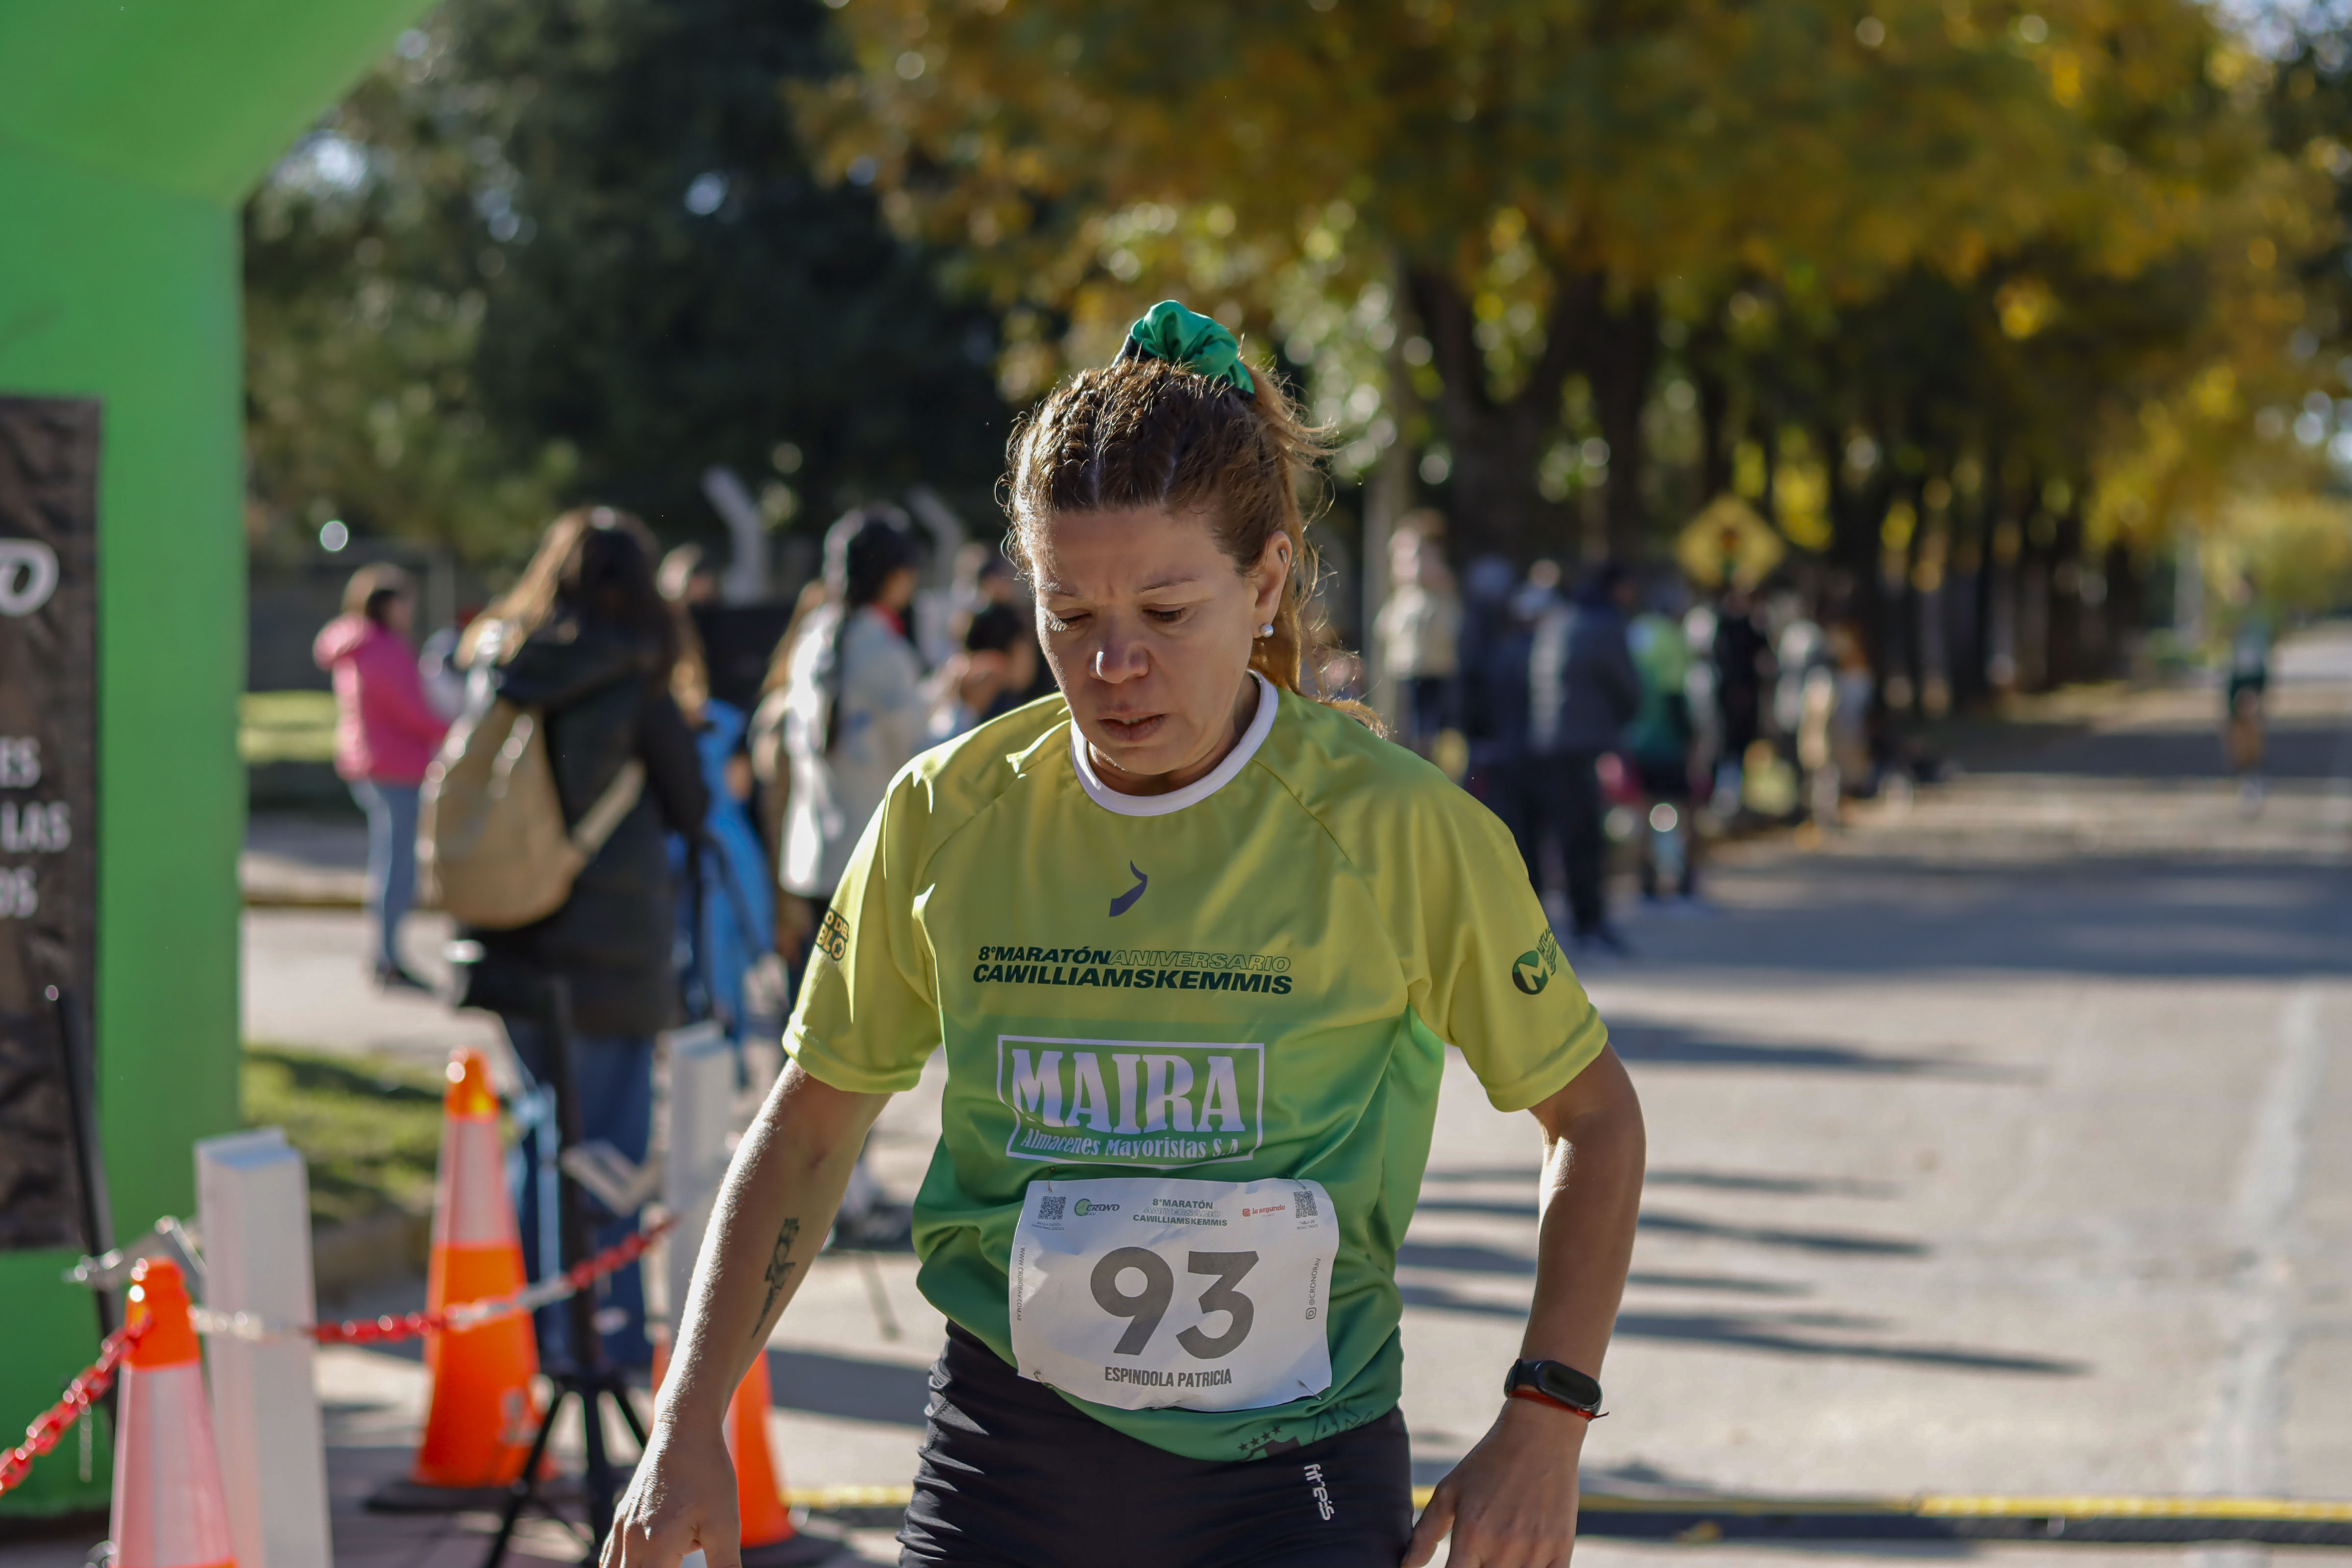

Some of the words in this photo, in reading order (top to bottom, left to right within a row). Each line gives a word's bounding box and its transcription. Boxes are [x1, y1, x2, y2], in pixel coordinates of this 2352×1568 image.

[973, 964, 1292, 995] CAWILLIAMSKEMMIS
[1012, 1049, 1246, 1134] MAIRA
[1021, 1128, 1101, 1155] Almacenes
[1105, 1137, 1206, 1159] Mayoristas
[1086, 1203, 1120, 1212] CRONO
[1133, 1214, 1227, 1226] CAWILLIAMSKEMMIS
[1143, 1207, 1222, 1218] ANIVERSARIO
[1259, 1204, 1286, 1213] segunda
[1309, 1258, 1321, 1305] @CRONORAV
[1091, 1247, 1259, 1359] 93
[1105, 1366, 1174, 1387] ESPINDOLA
[1177, 1369, 1232, 1388] PATRICIA
